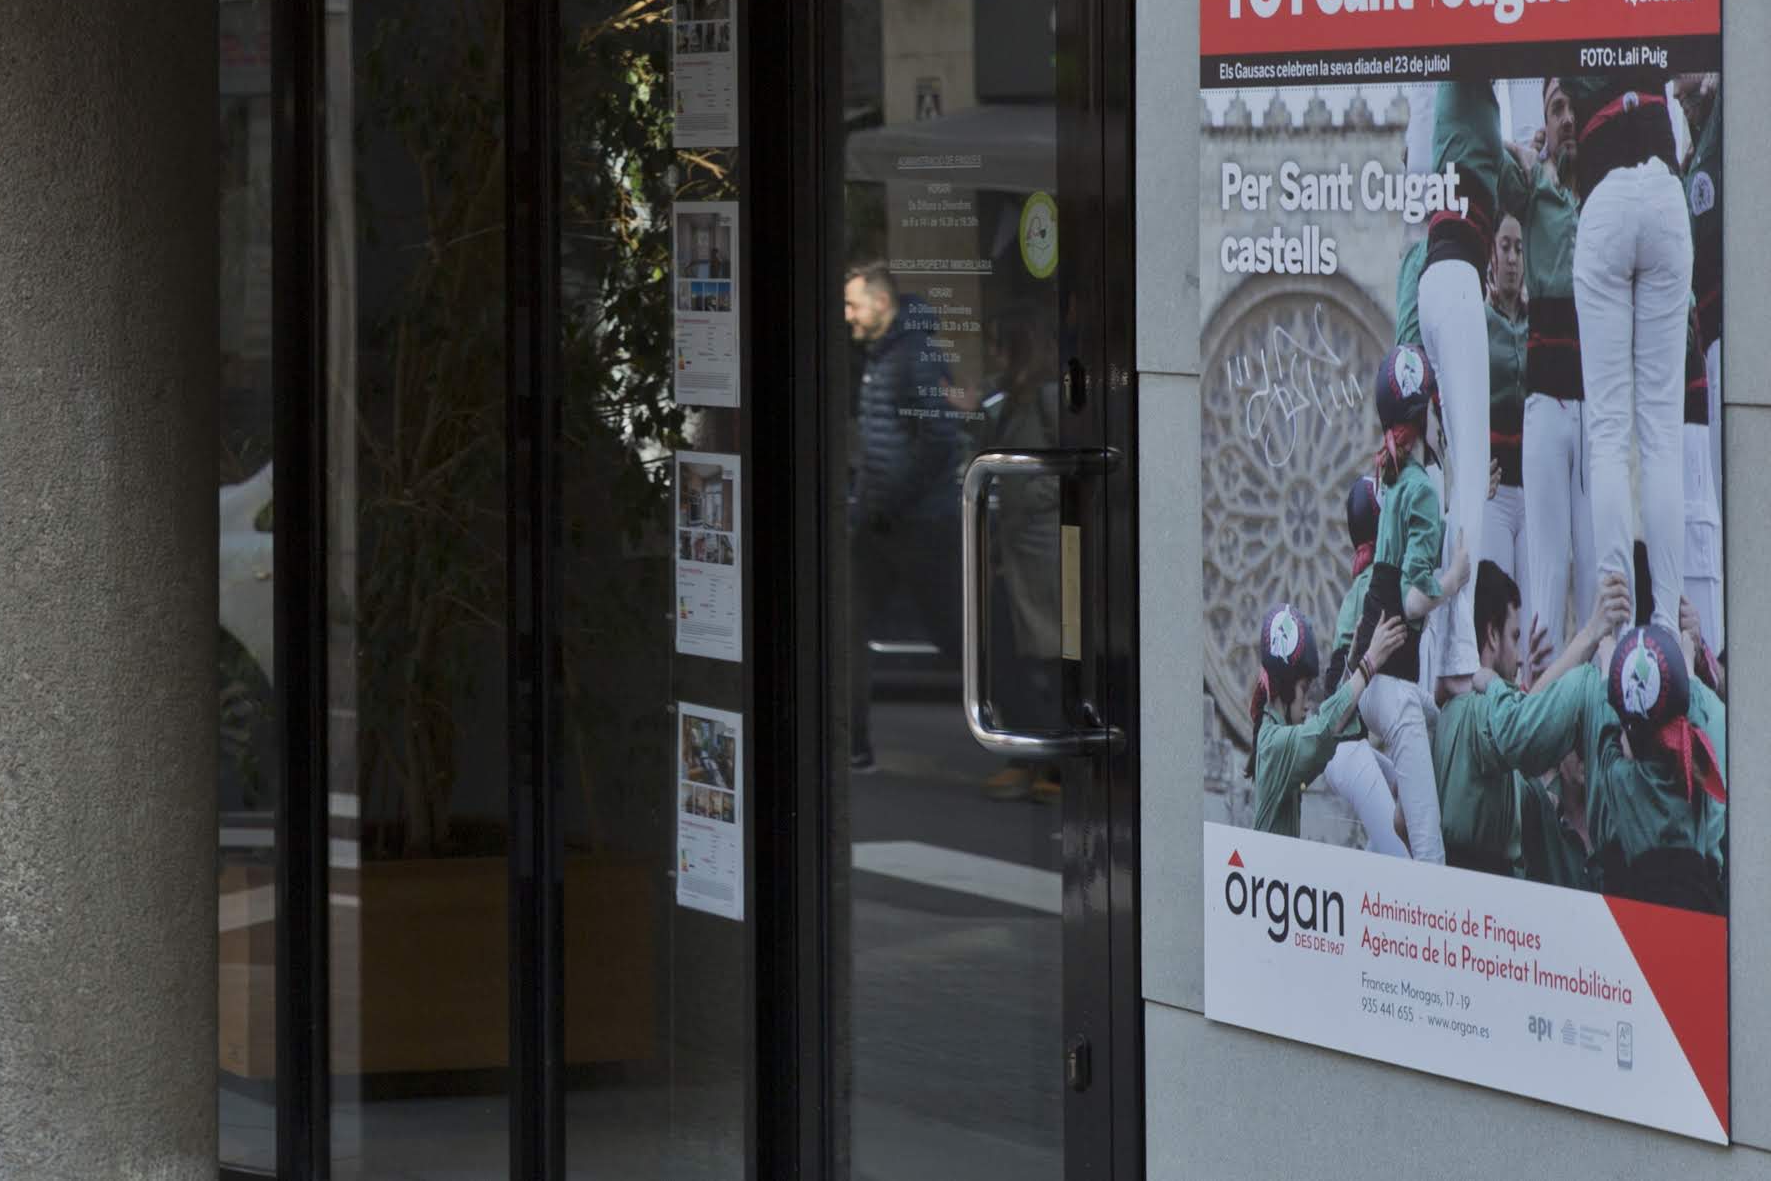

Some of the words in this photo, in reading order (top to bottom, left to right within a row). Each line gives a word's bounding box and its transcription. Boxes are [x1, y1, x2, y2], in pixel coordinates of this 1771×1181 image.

[1220, 63, 1234, 80] Els
[1235, 61, 1275, 79] Gausacs
[1276, 60, 1319, 78] celebren
[1320, 60, 1329, 76] la
[1330, 60, 1353, 76] seva
[1354, 57, 1382, 75] diada
[1383, 56, 1394, 74] el
[1395, 55, 1409, 73] 23
[1409, 56, 1423, 73] de
[1423, 54, 1450, 76] juliol
[1580, 48, 1616, 67] FOTO:
[1618, 47, 1639, 66] Lali
[1641, 46, 1668, 68] Puig
[1221, 162, 1272, 212] Per
[1279, 161, 1353, 212] Sant
[1360, 160, 1469, 224] Cugat,
[1221, 225, 1338, 275] castells
[1361, 891, 1457, 934] Administració
[1461, 913, 1479, 938] de
[1484, 914, 1542, 952] Finques
[1327, 940, 1345, 956] 1967
[1361, 926, 1418, 960] Agència
[1422, 936, 1439, 964] de
[1443, 939, 1457, 968] la
[1462, 946, 1529, 983] Propietat
[1534, 961, 1632, 1005] Immobiliària
[1361, 971, 1398, 995] Francesc
[1401, 981, 1443, 1007] Moragas,
[1361, 997, 1378, 1014] 935
[1380, 1002, 1394, 1018] 441
[1397, 1005, 1414, 1022] 655
[1427, 1015, 1490, 1039] www.organ.es
